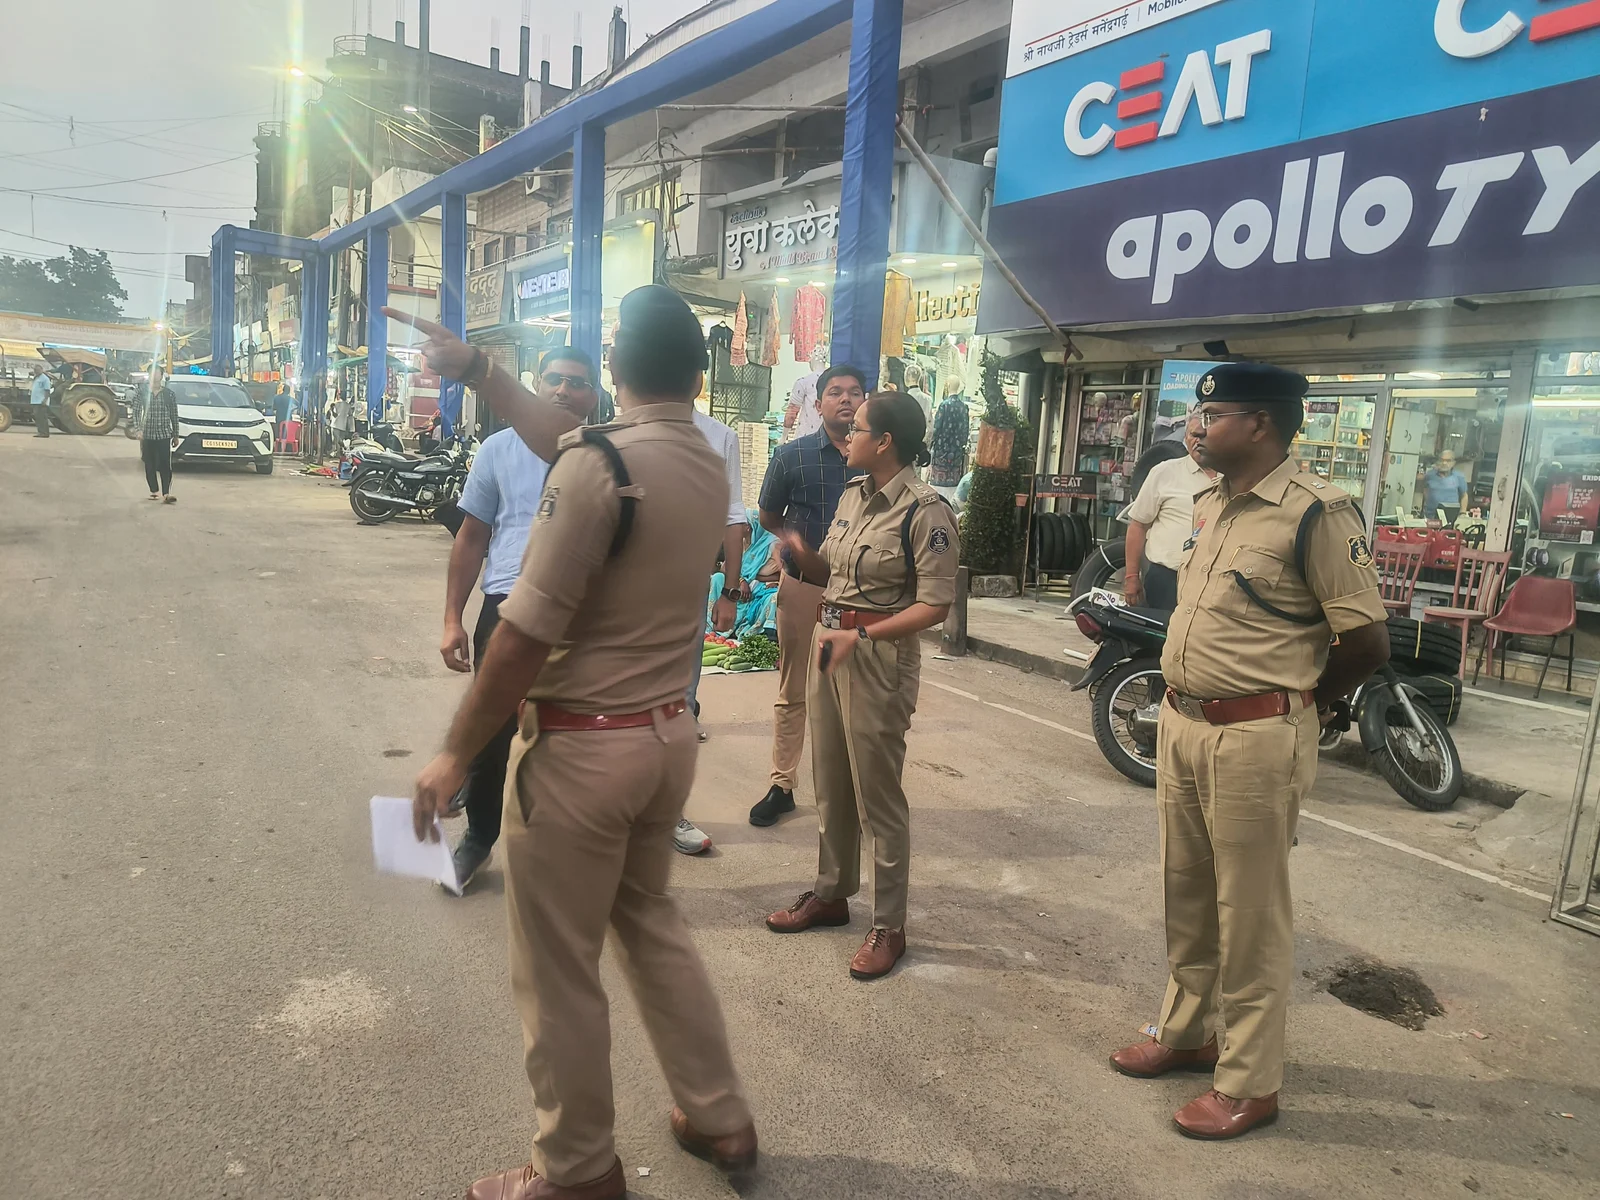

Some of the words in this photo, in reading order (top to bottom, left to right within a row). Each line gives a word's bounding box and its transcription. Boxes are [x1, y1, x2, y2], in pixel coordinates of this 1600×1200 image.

[1023, 46, 1034, 63] श्री
[1067, 23, 1089, 49] ट्रेडर्स
[1063, 28, 1272, 157] CEAT
[725, 220, 769, 270] युवा
[1105, 150, 1413, 305] apollo
[1051, 476, 1083, 488] CEAT
